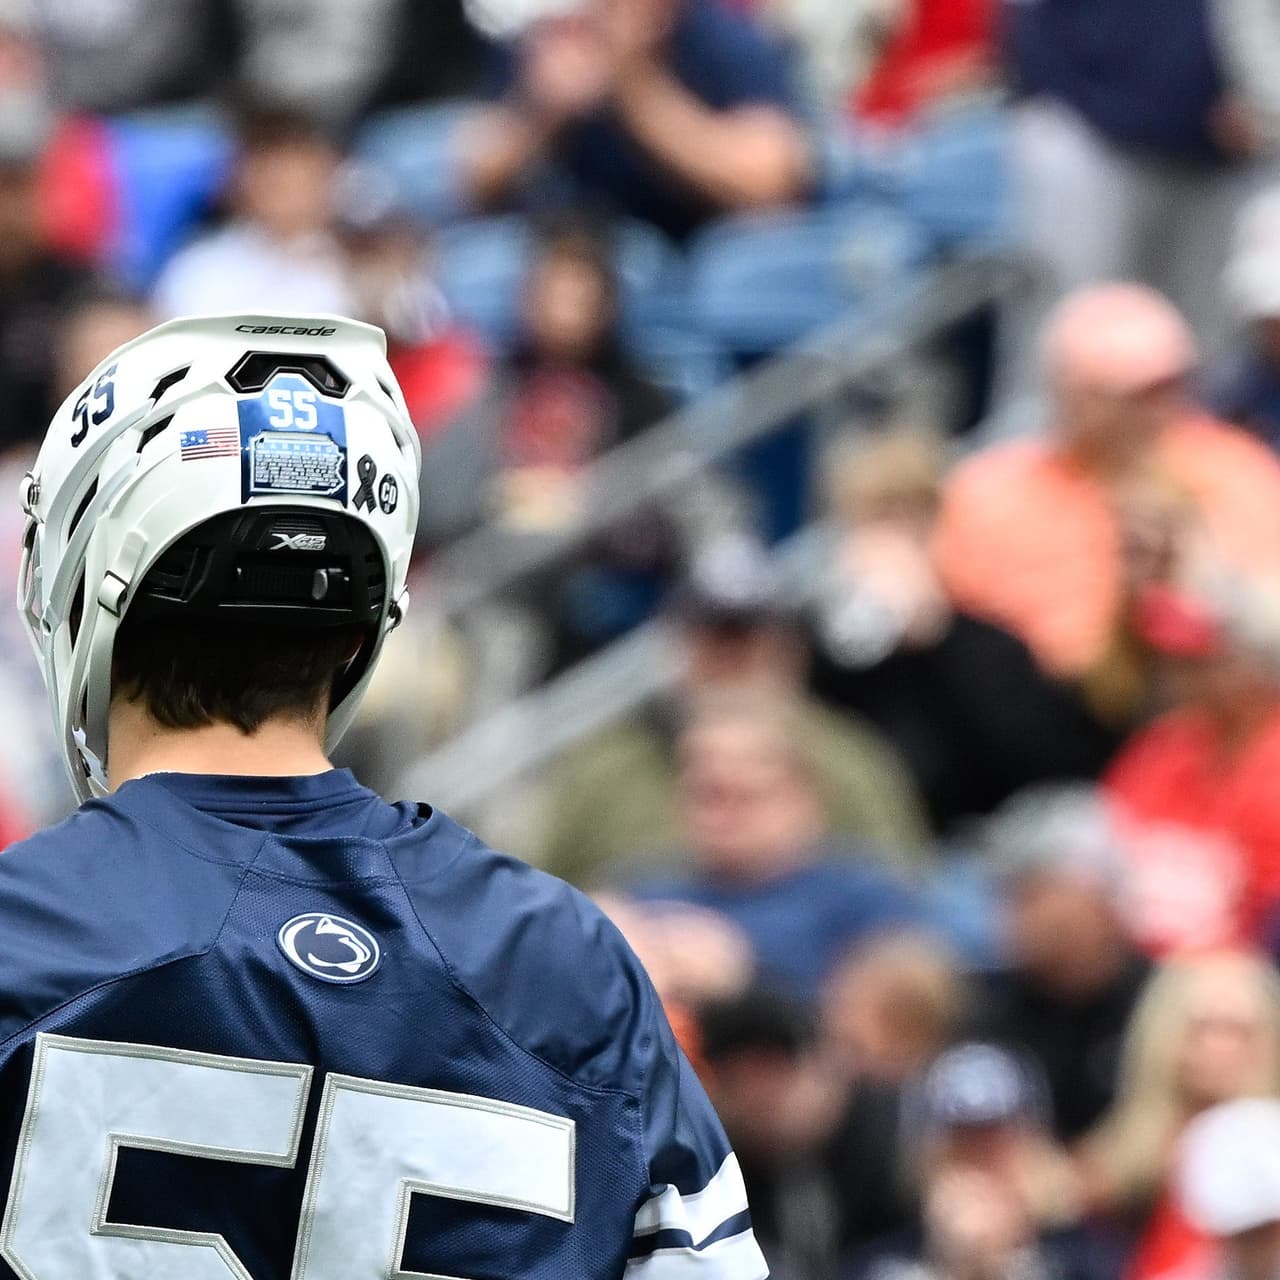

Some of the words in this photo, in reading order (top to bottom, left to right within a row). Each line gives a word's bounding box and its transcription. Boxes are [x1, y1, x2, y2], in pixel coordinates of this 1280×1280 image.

[70, 362, 119, 449] 55
[268, 388, 318, 430] 55
[380, 481, 397, 506] CD
